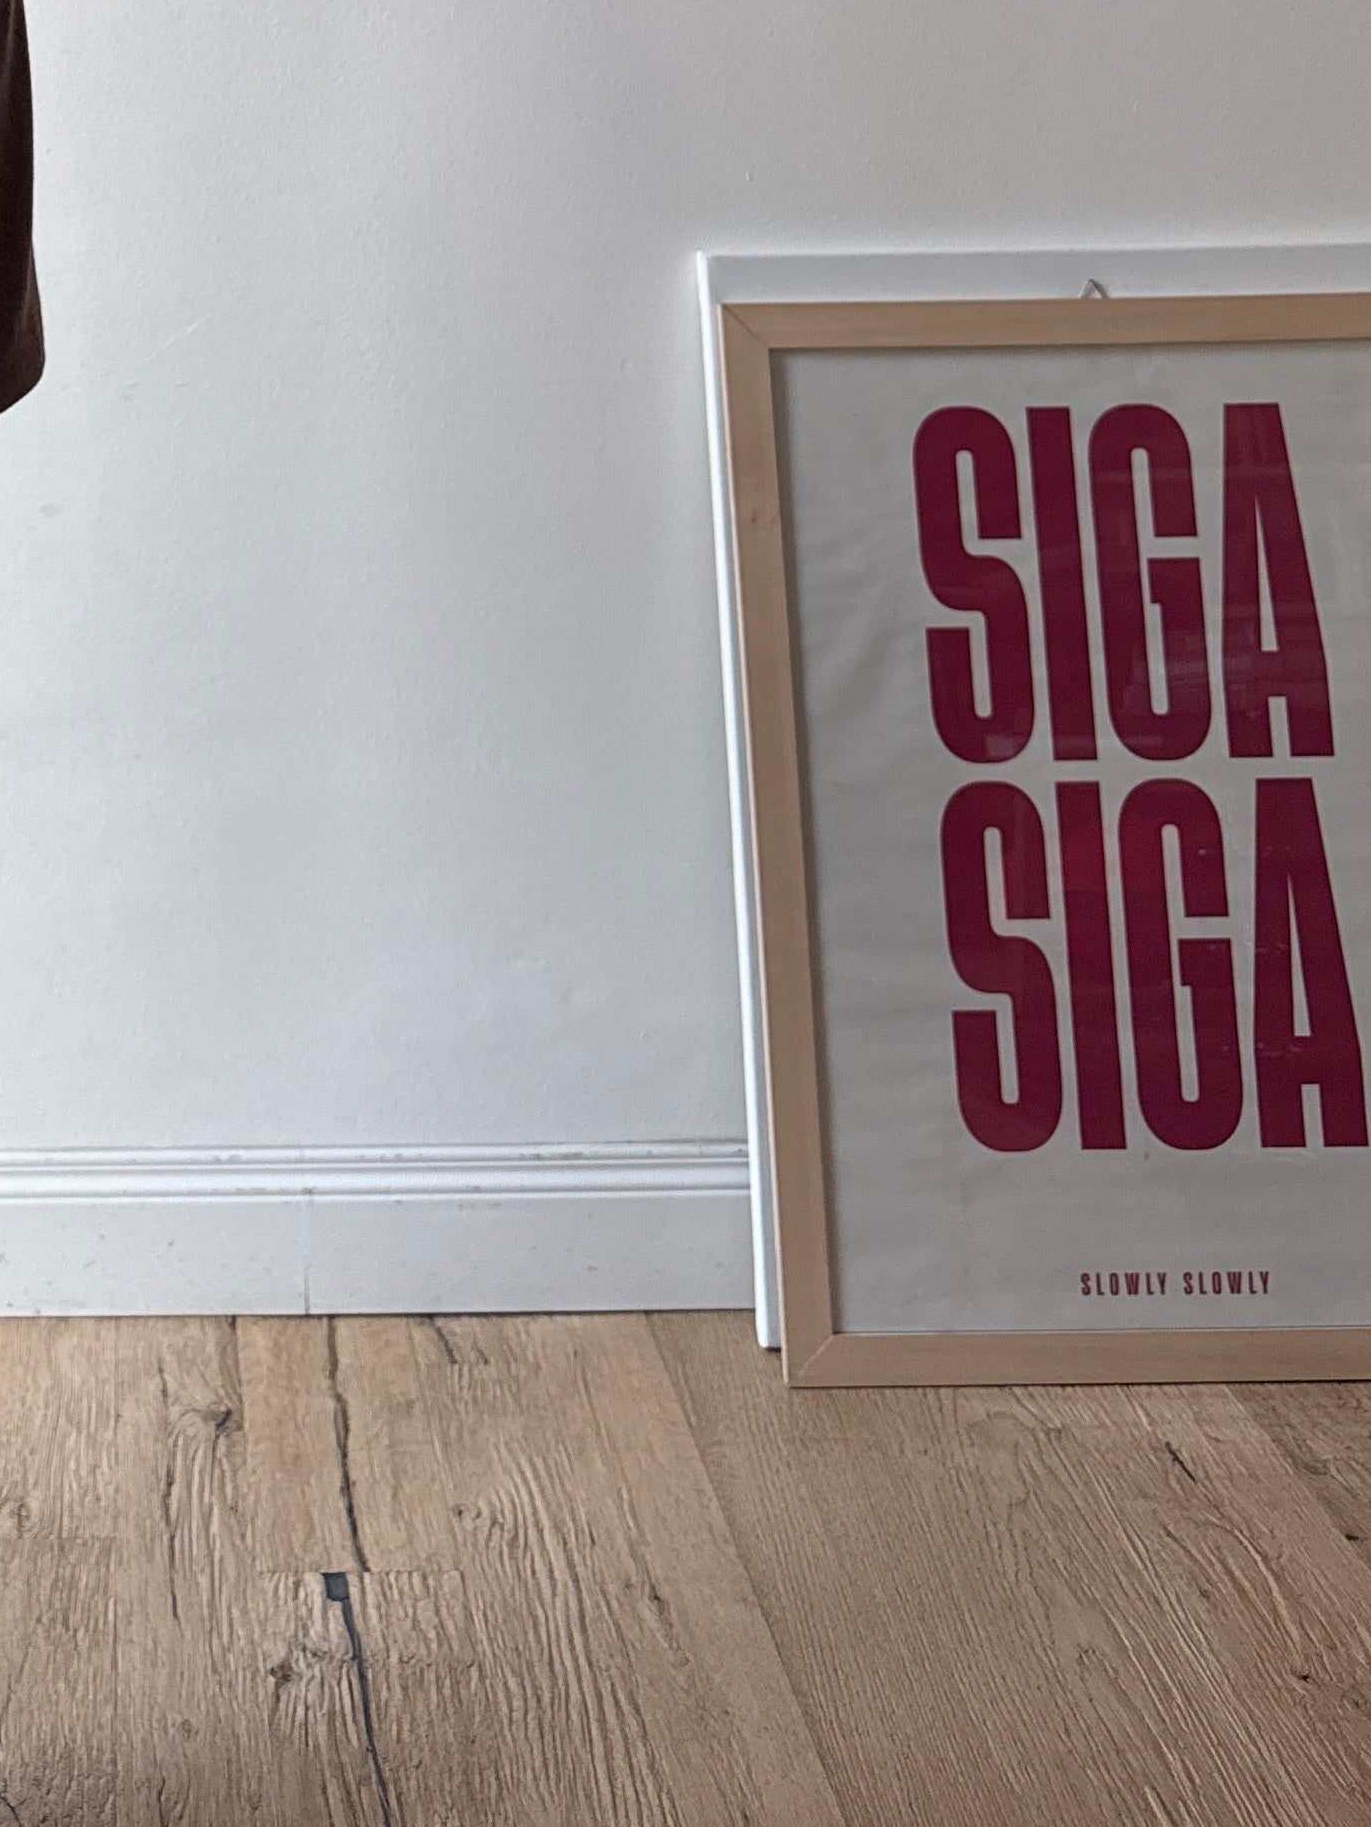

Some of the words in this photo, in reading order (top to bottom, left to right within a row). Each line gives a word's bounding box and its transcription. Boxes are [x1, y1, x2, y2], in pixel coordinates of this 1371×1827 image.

[913, 403, 1335, 764] SIGA
[940, 776, 1371, 1153] SIGA
[1080, 1272, 1167, 1296] SLOWLY
[1182, 1271, 1269, 1295] SLOWLY
